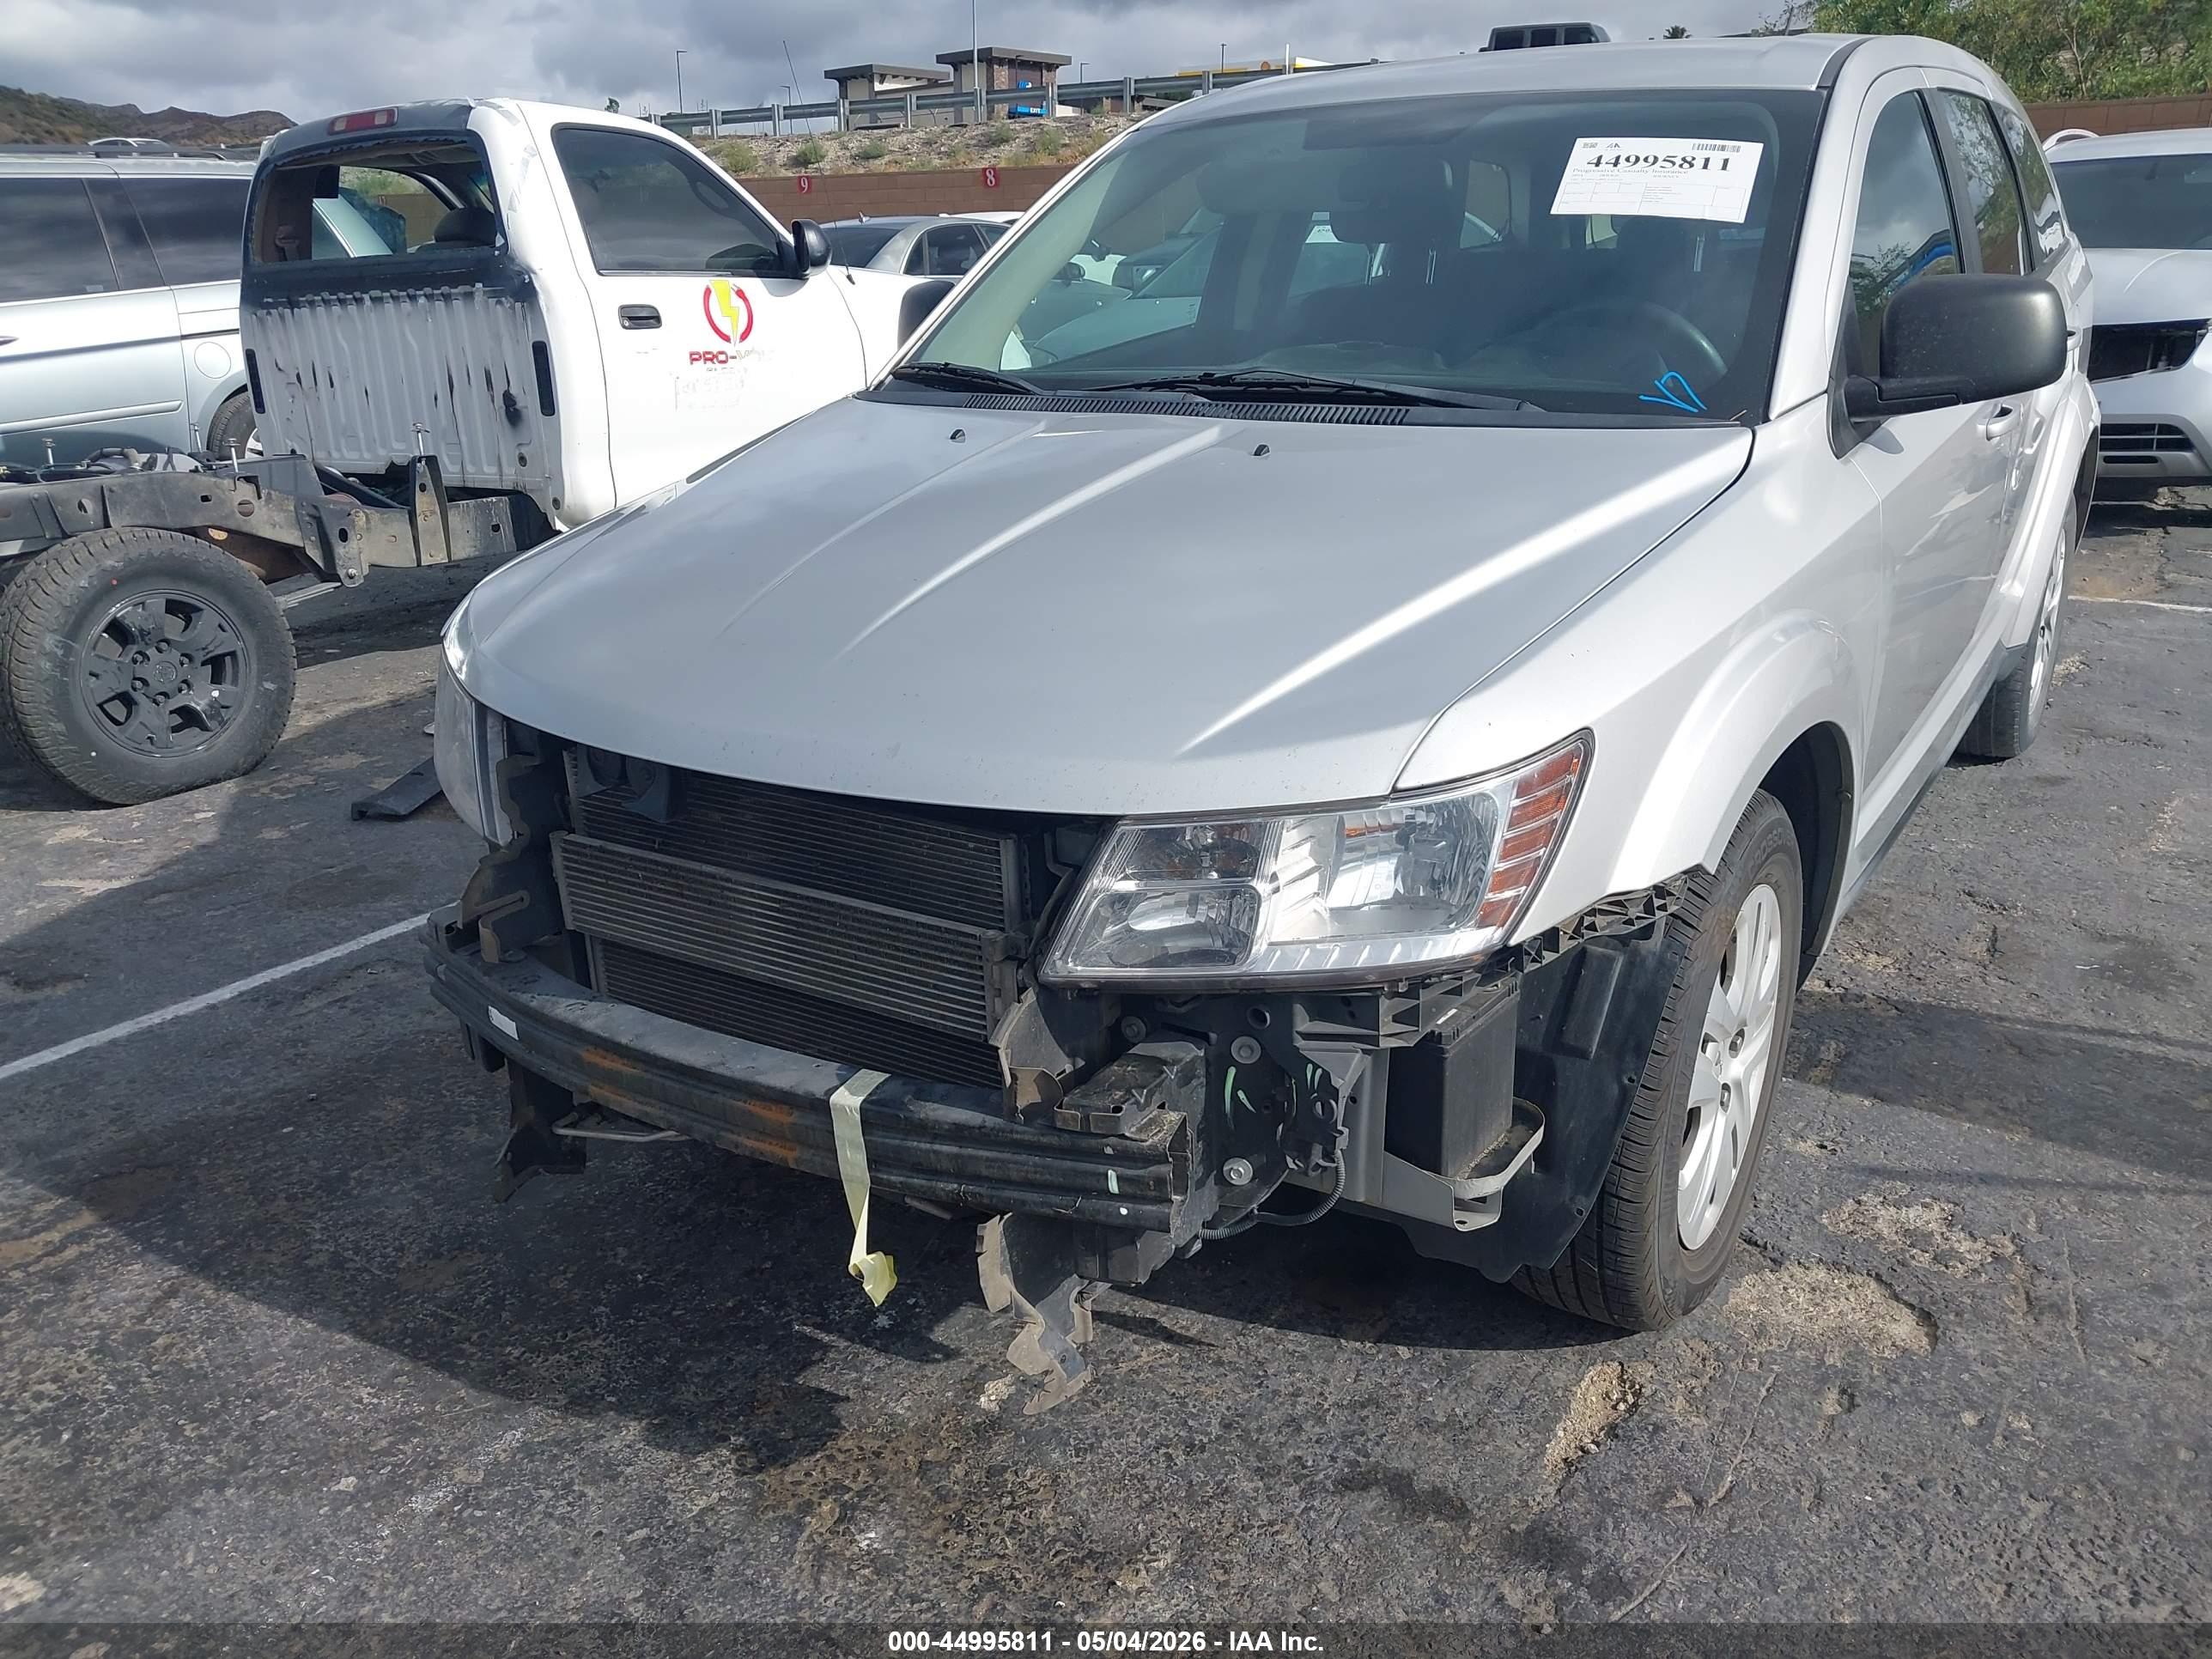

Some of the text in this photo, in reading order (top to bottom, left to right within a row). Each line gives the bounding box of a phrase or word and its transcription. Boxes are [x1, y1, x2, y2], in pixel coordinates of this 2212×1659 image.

[1587, 154, 1731, 173] 44995811
[800, 177, 809, 193] 9
[986, 168, 996, 186] 8
